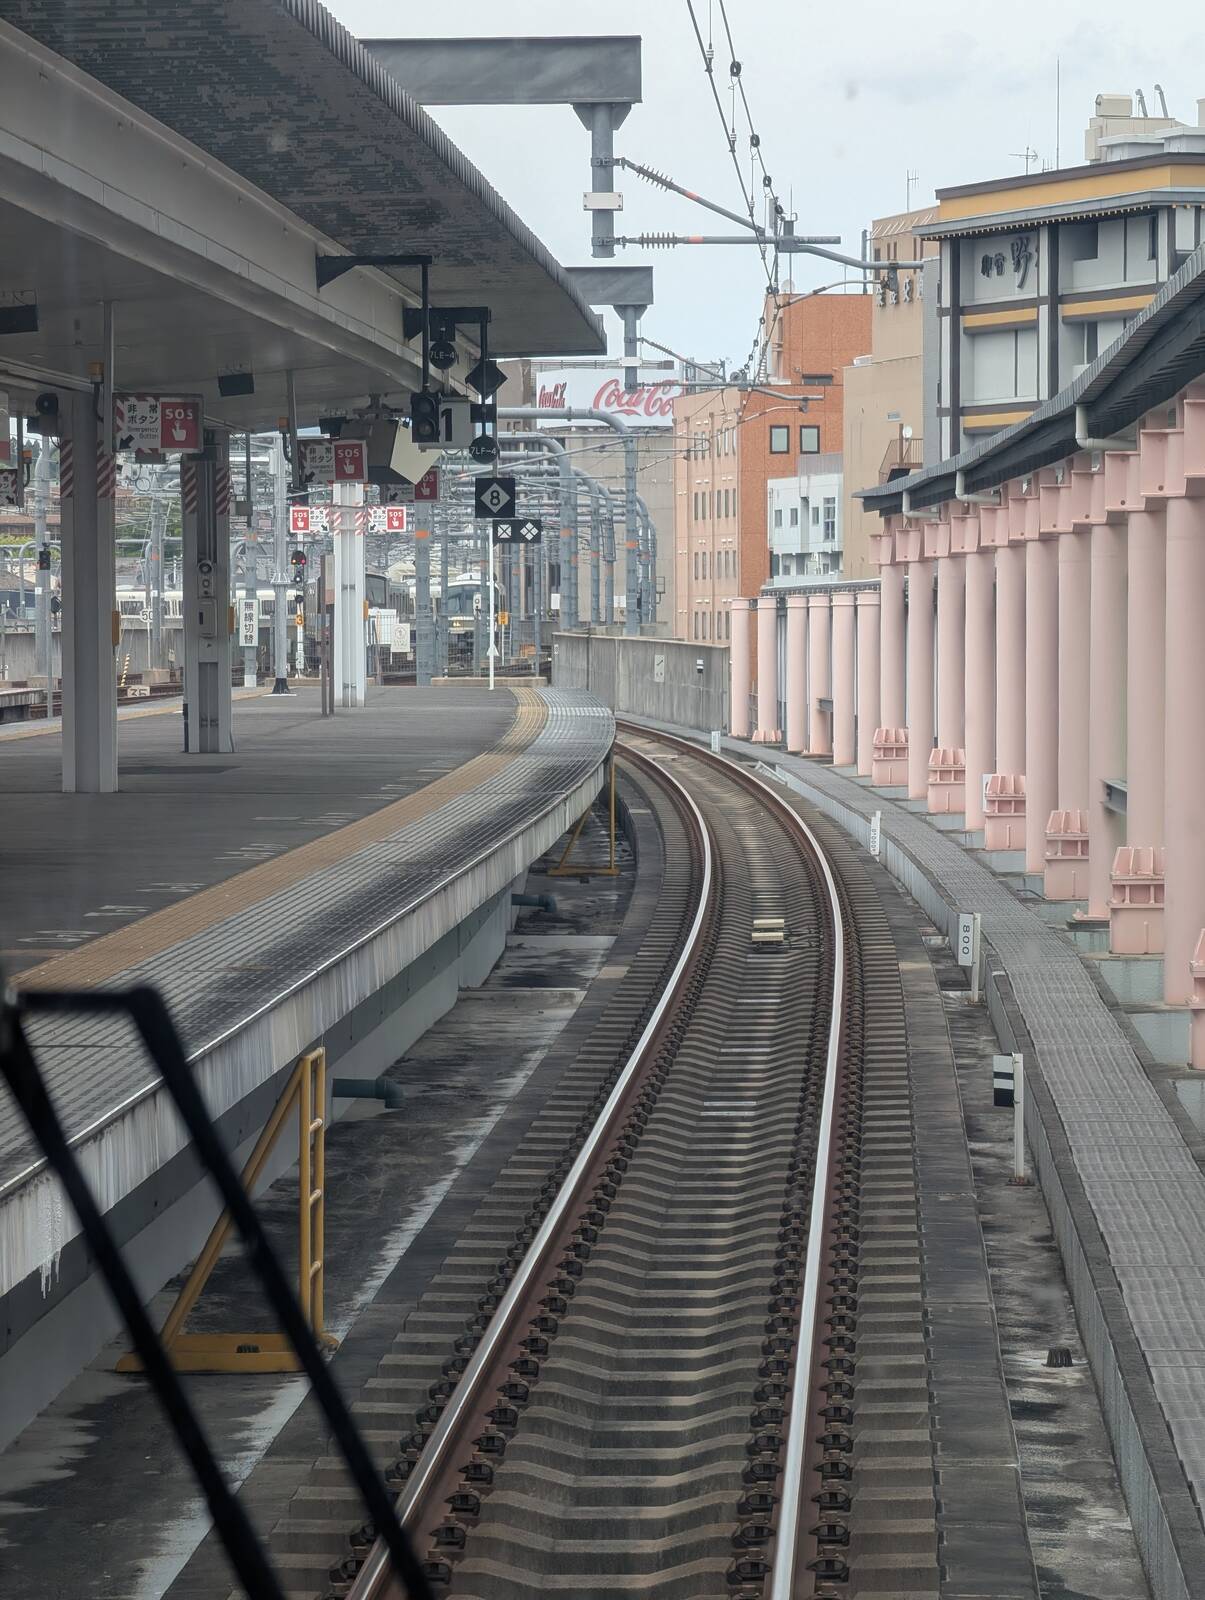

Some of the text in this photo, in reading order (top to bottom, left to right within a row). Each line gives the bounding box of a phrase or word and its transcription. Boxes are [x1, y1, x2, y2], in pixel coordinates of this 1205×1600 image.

[593, 379, 680, 416] Coca-Co
[127, 415, 159, 425] ボタン
[165, 408, 193, 420] SOS
[440, 408, 453, 442] 1
[337, 449, 360, 458] SOS
[490, 490, 500, 506] 8
[962, 924, 970, 955] 800
